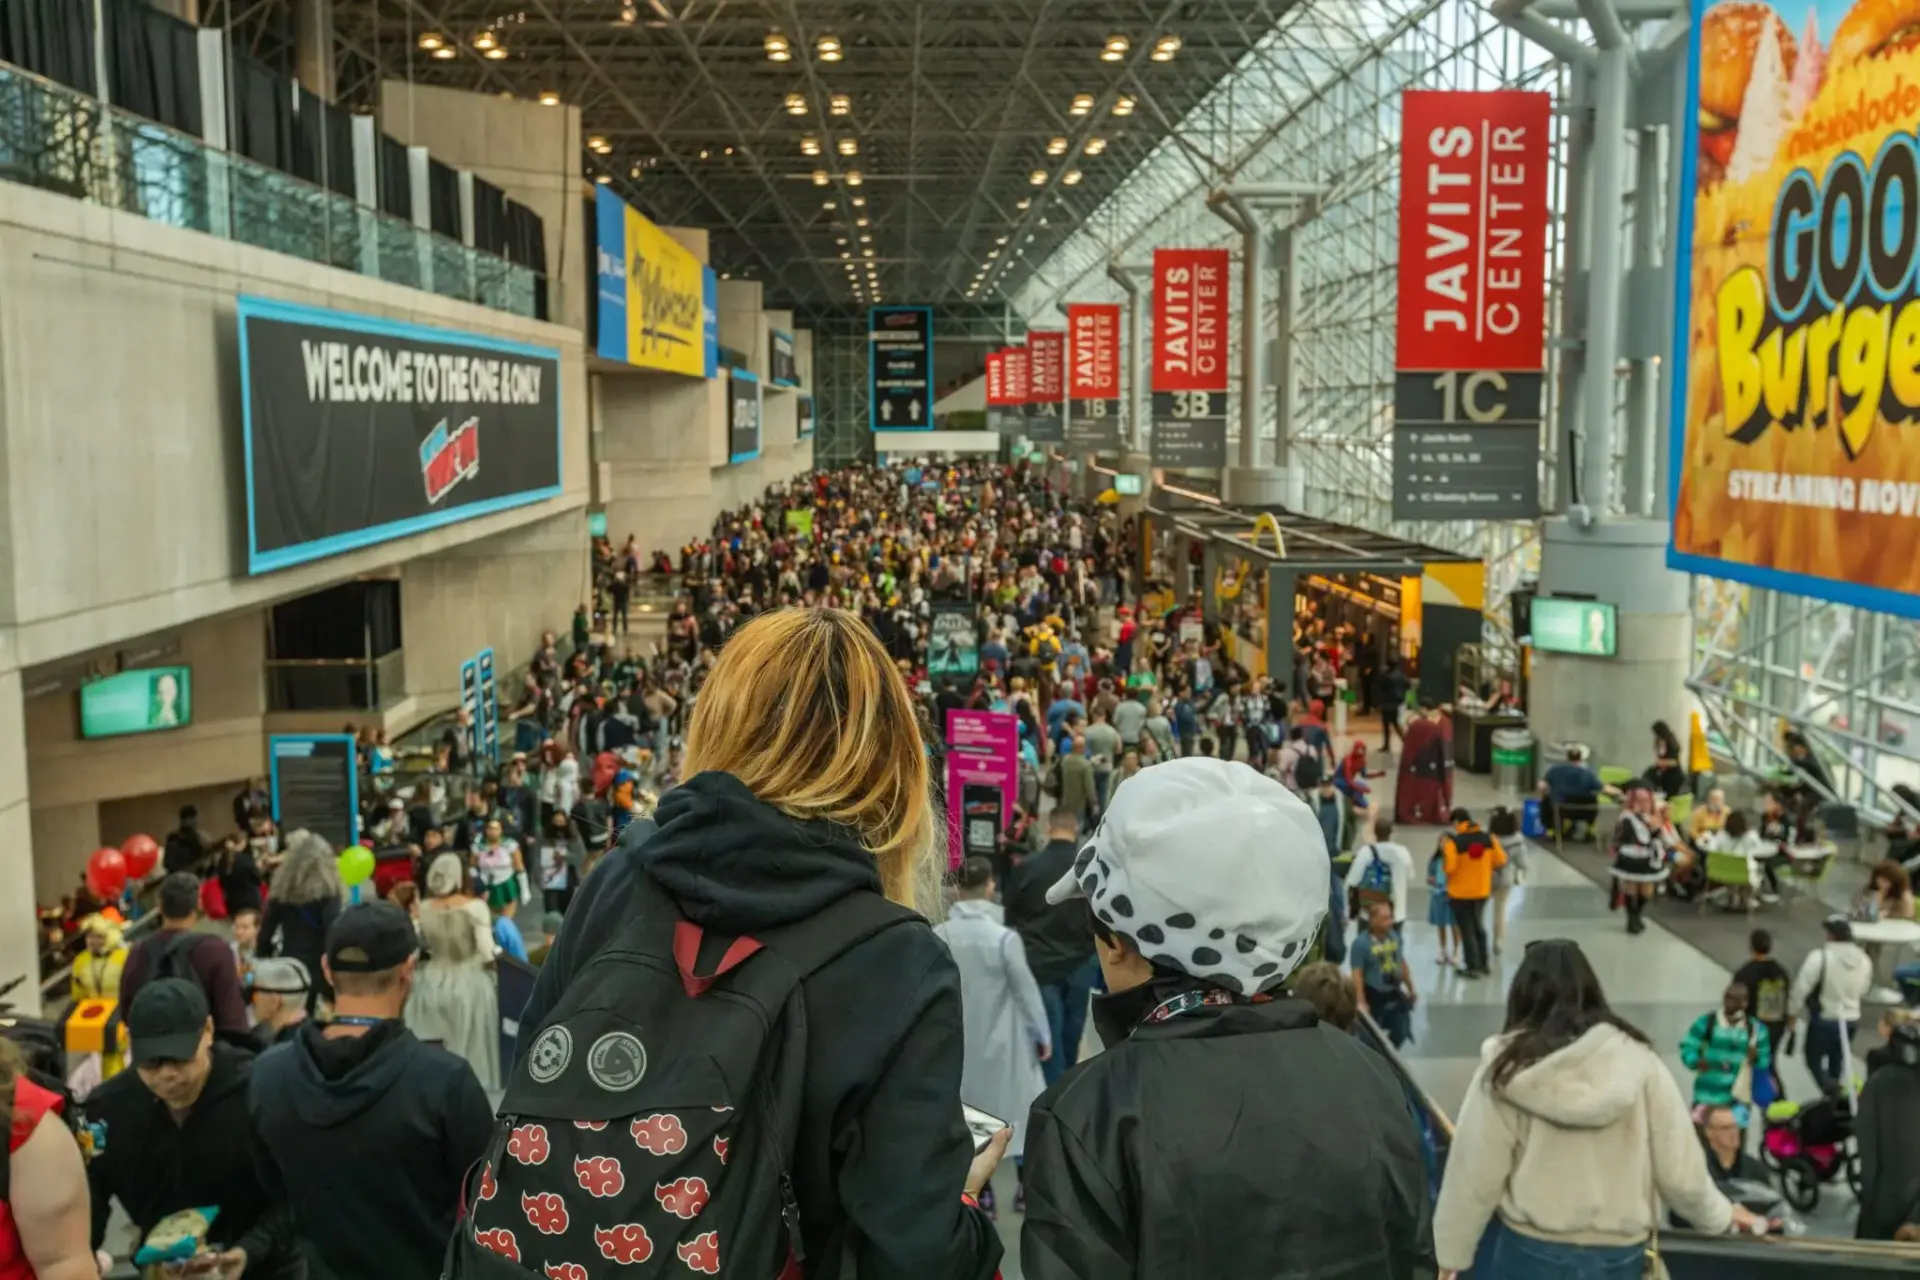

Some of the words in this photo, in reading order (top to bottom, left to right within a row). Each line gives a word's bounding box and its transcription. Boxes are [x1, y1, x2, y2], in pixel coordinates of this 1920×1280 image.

[1424, 126, 1473, 332] JAVITS
[1486, 126, 1526, 335] CENTER
[1769, 129, 1920, 321] GOO
[1076, 315, 1094, 388] JAVITS
[1097, 314, 1113, 388] CENTER
[1164, 266, 1190, 373] JAVITS
[1197, 266, 1218, 374] CENTER
[301, 339, 414, 402] WELCOME
[413, 352, 438, 403] TO
[438, 354, 469, 402] THE
[470, 358, 500, 403] ONE
[510, 363, 541, 404] ONLY
[1031, 340, 1045, 393] JAVITS
[1433, 371, 1508, 424] 1C
[1083, 399, 1107, 418] 1B
[1171, 391, 1210, 419] 3B
[1727, 469, 1855, 511] STREAMING
